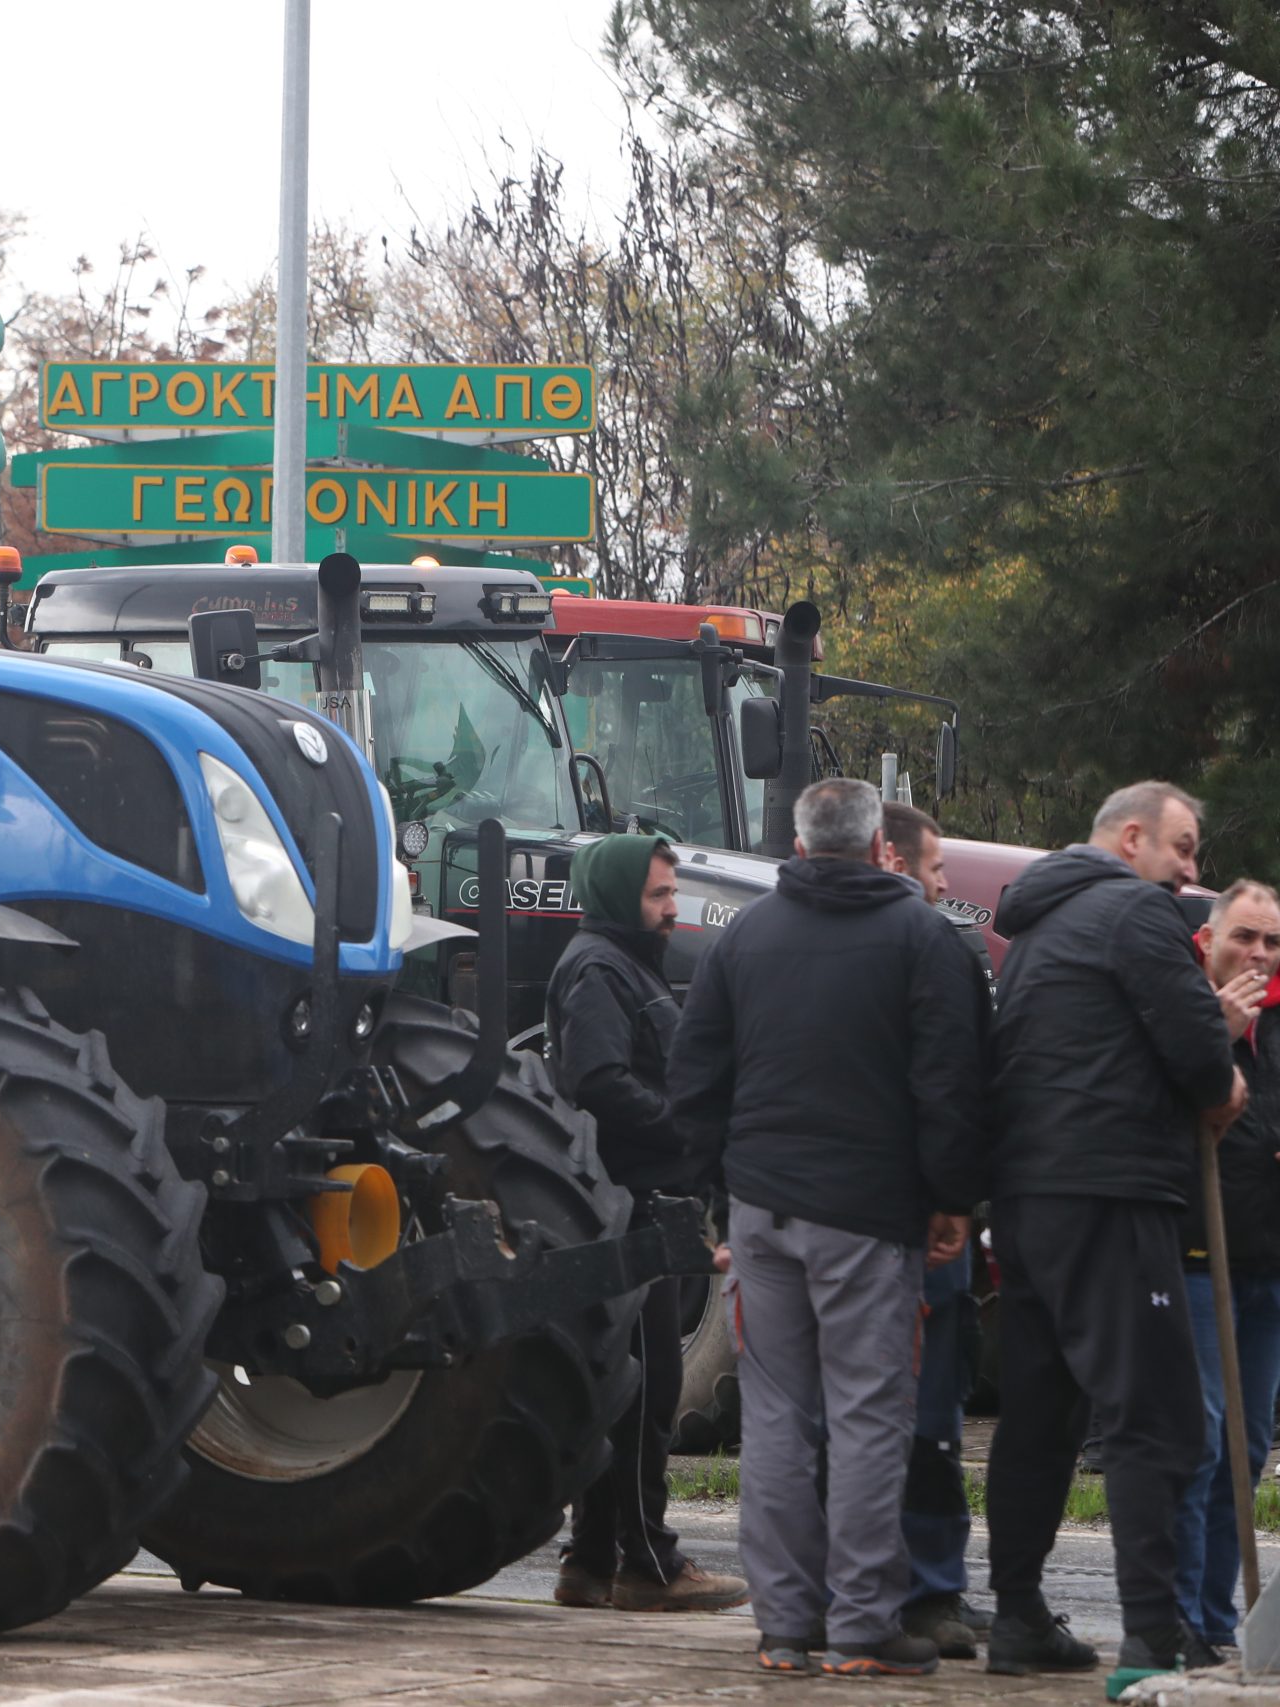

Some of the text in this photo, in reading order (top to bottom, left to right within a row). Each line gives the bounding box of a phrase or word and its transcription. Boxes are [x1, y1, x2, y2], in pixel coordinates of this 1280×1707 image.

[444, 374, 588, 420] Α.Π.Θ.
[322, 696, 352, 710] JSA
[459, 876, 567, 910] CSE
